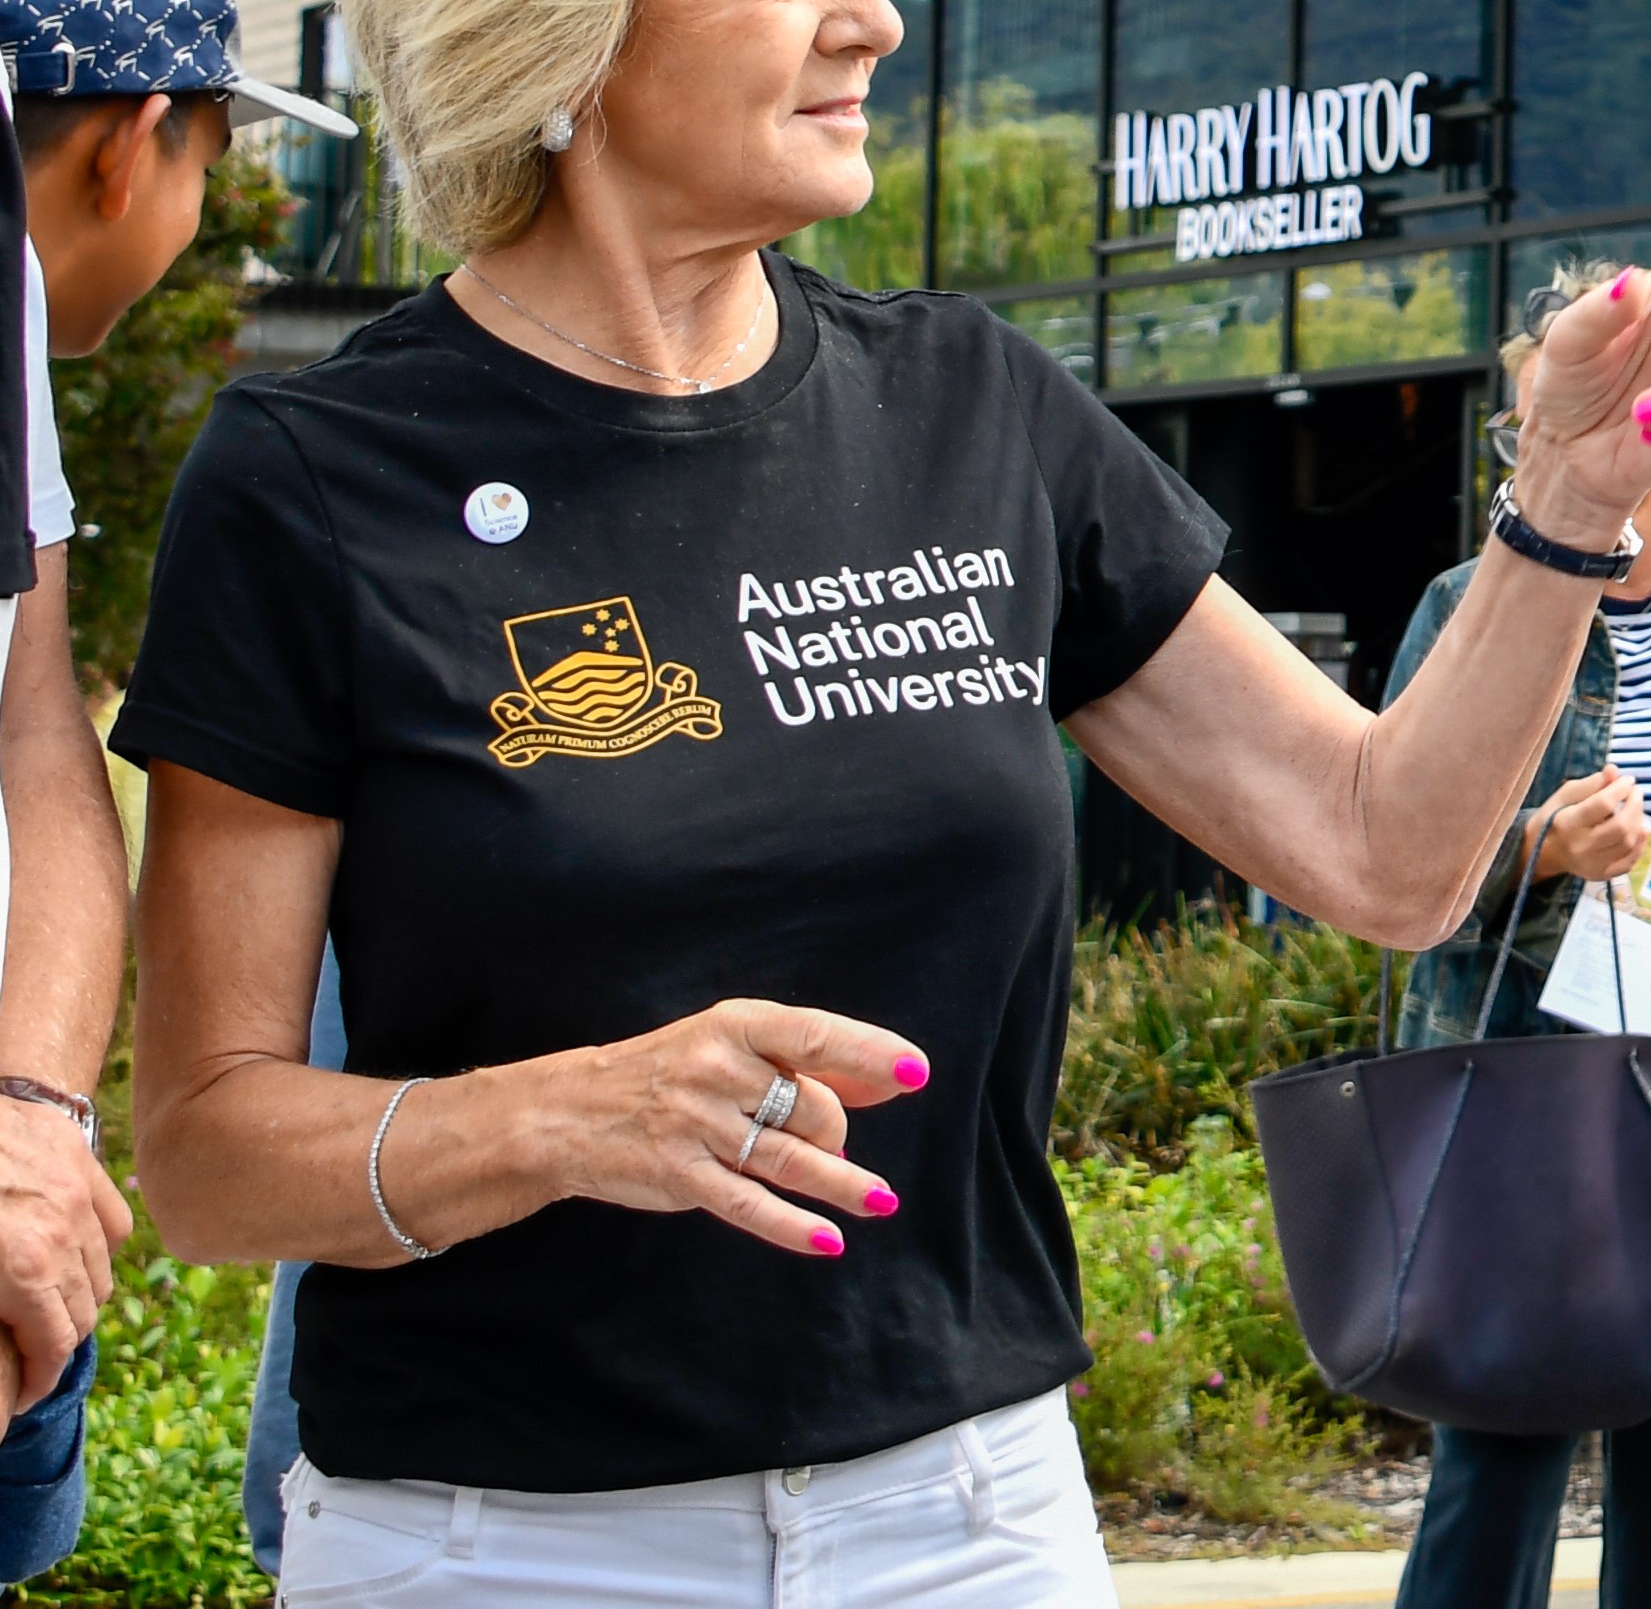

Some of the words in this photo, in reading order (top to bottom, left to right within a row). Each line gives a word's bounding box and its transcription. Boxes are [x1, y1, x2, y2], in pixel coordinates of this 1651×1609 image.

[1113, 99, 1254, 212] HARRY
[1254, 70, 1433, 190] HARTOG
[1174, 184, 1364, 264] BOOKSELLER
[736, 544, 1016, 623] Australian
[744, 594, 995, 676] National
[499, 733, 558, 753] NATURAM
[557, 733, 608, 751] PRIMUM
[671, 703, 712, 719] RERUM
[762, 652, 1048, 728] University
